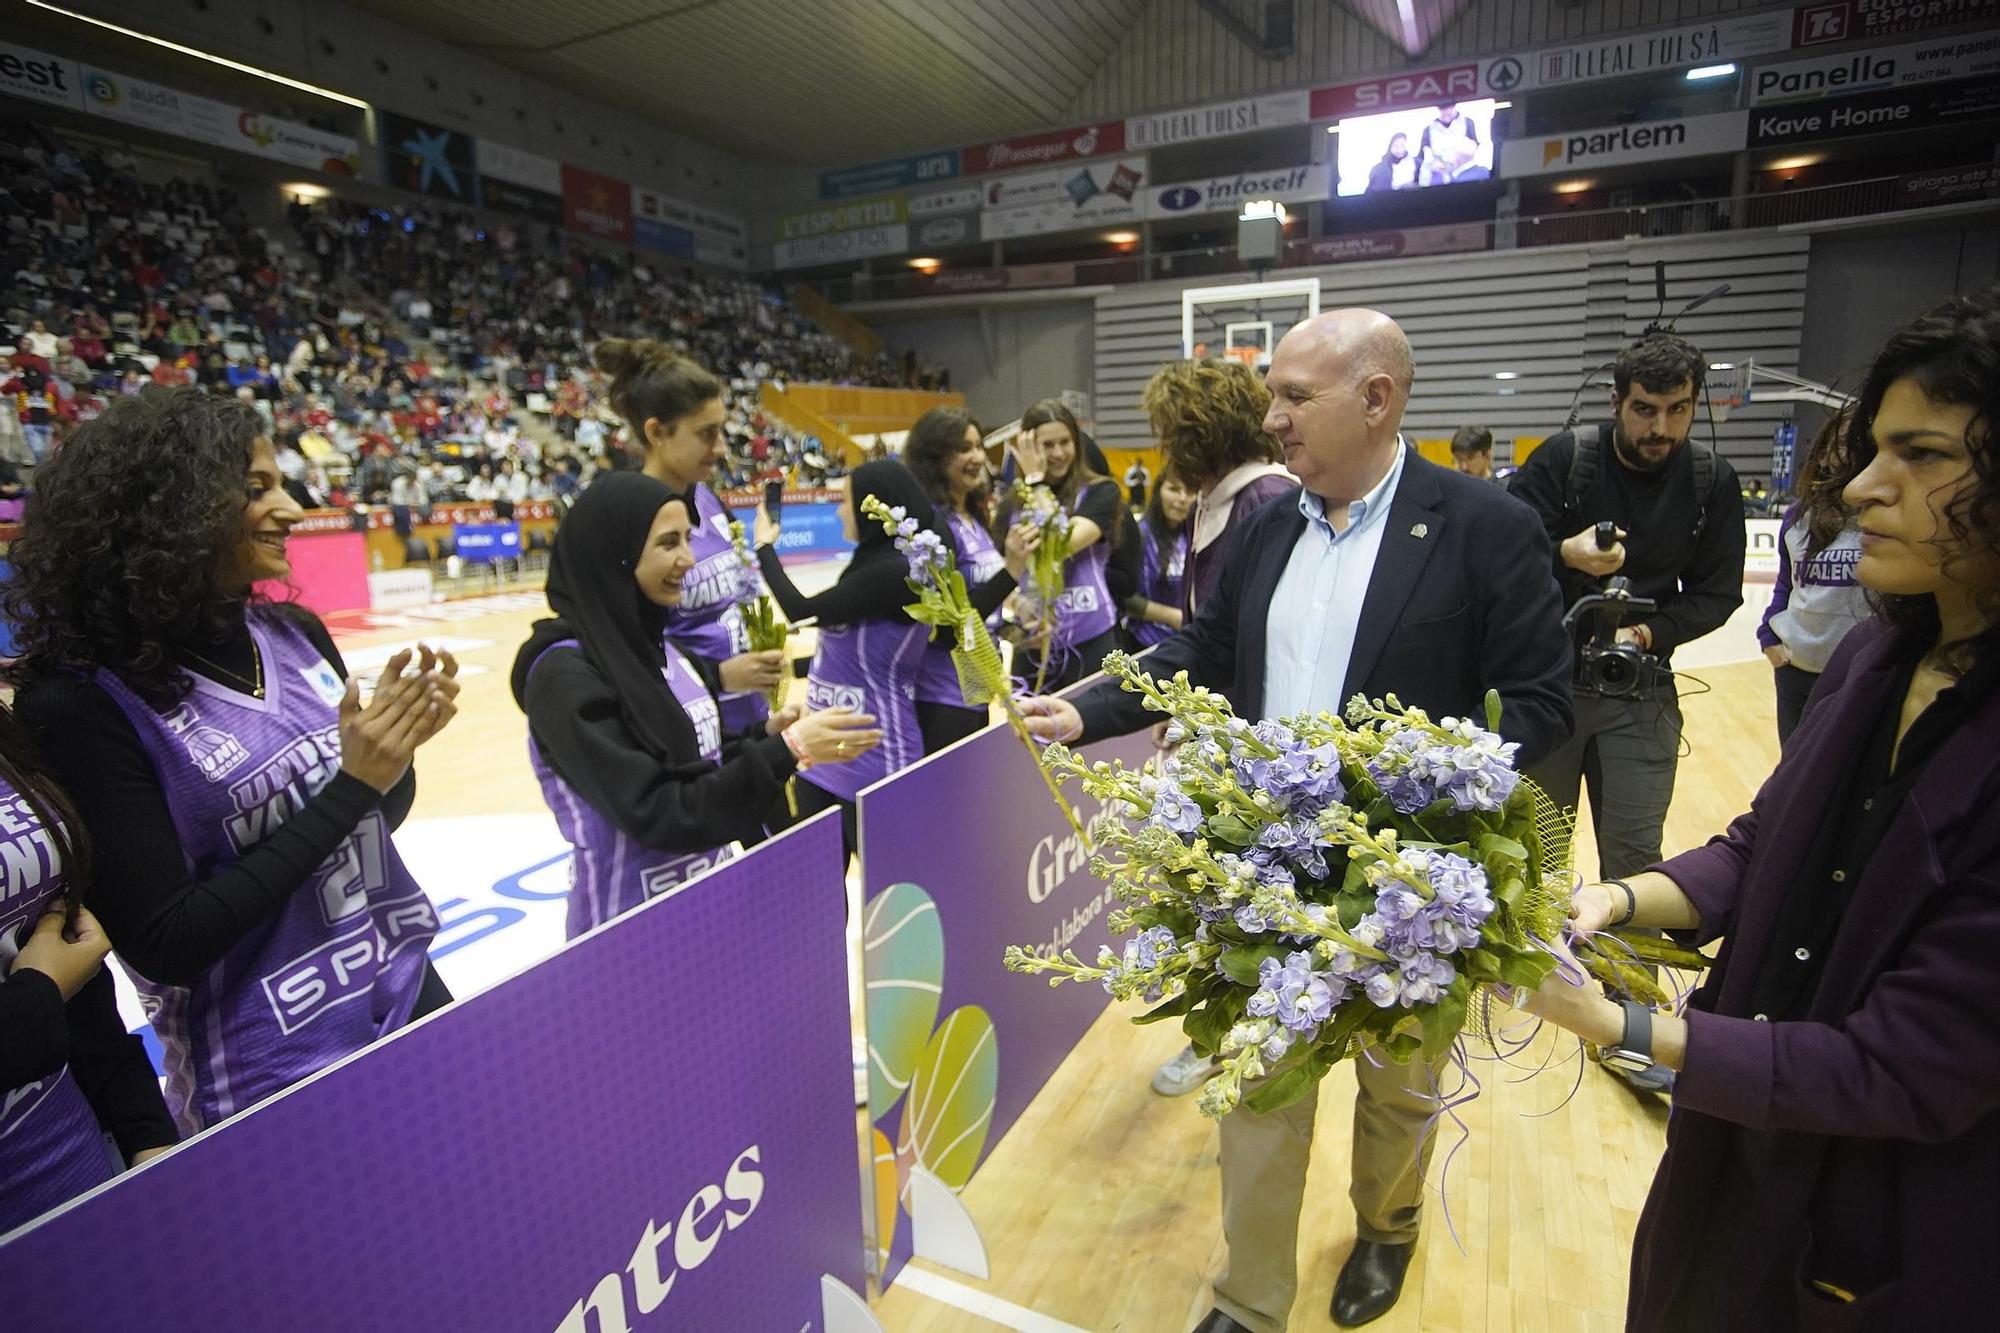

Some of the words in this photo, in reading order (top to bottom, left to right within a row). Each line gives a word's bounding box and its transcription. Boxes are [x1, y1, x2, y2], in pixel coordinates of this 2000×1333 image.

[1574, 42, 1634, 78] LLEAL
[1758, 56, 1895, 96] Panella
[1354, 70, 1476, 108] SPAR
[1152, 113, 1198, 142] LLEAL
[1758, 116, 1821, 138] Kave
[1830, 104, 1910, 128] Home
[1206, 169, 1308, 199] infoself
[1907, 175, 1959, 191] girona
[202, 739, 239, 772] UNI
